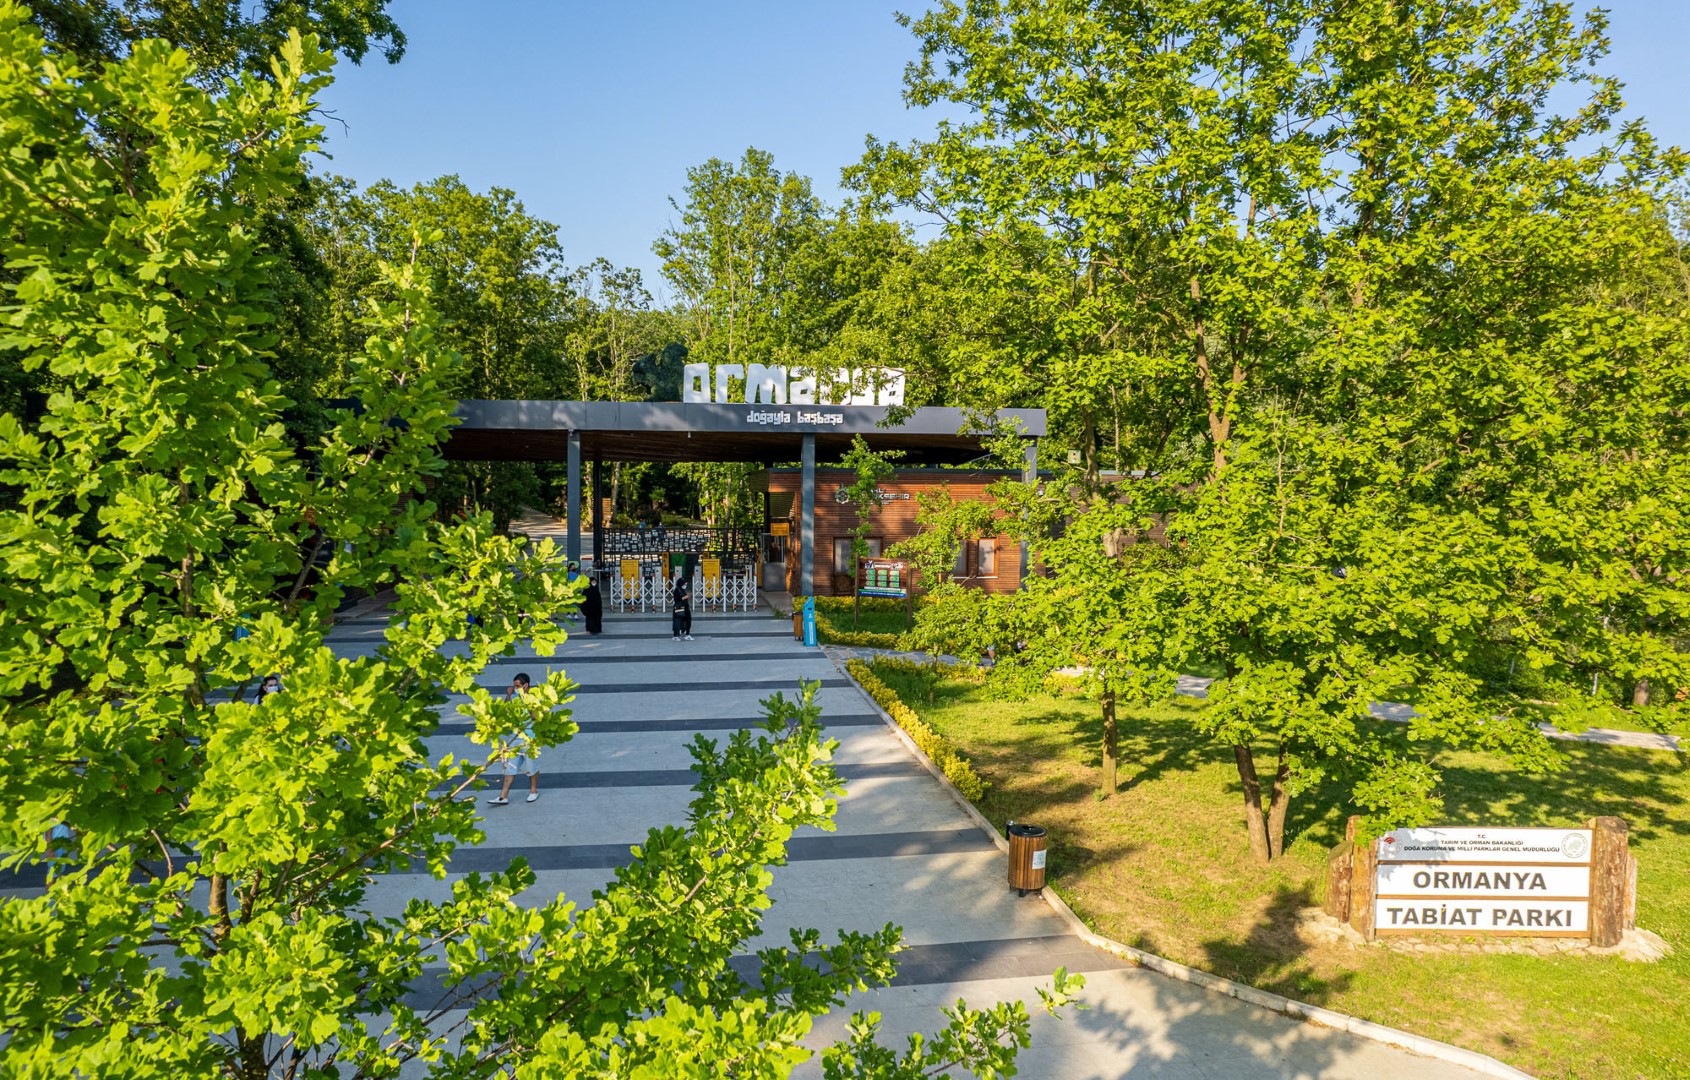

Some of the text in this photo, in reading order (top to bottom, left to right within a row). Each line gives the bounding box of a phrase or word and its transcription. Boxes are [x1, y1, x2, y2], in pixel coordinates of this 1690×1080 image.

[747, 410, 843, 426] doğayla başbaşa
[1413, 871, 1547, 890] ORMANYA
[1387, 904, 1572, 927] TABİAT PARKI
